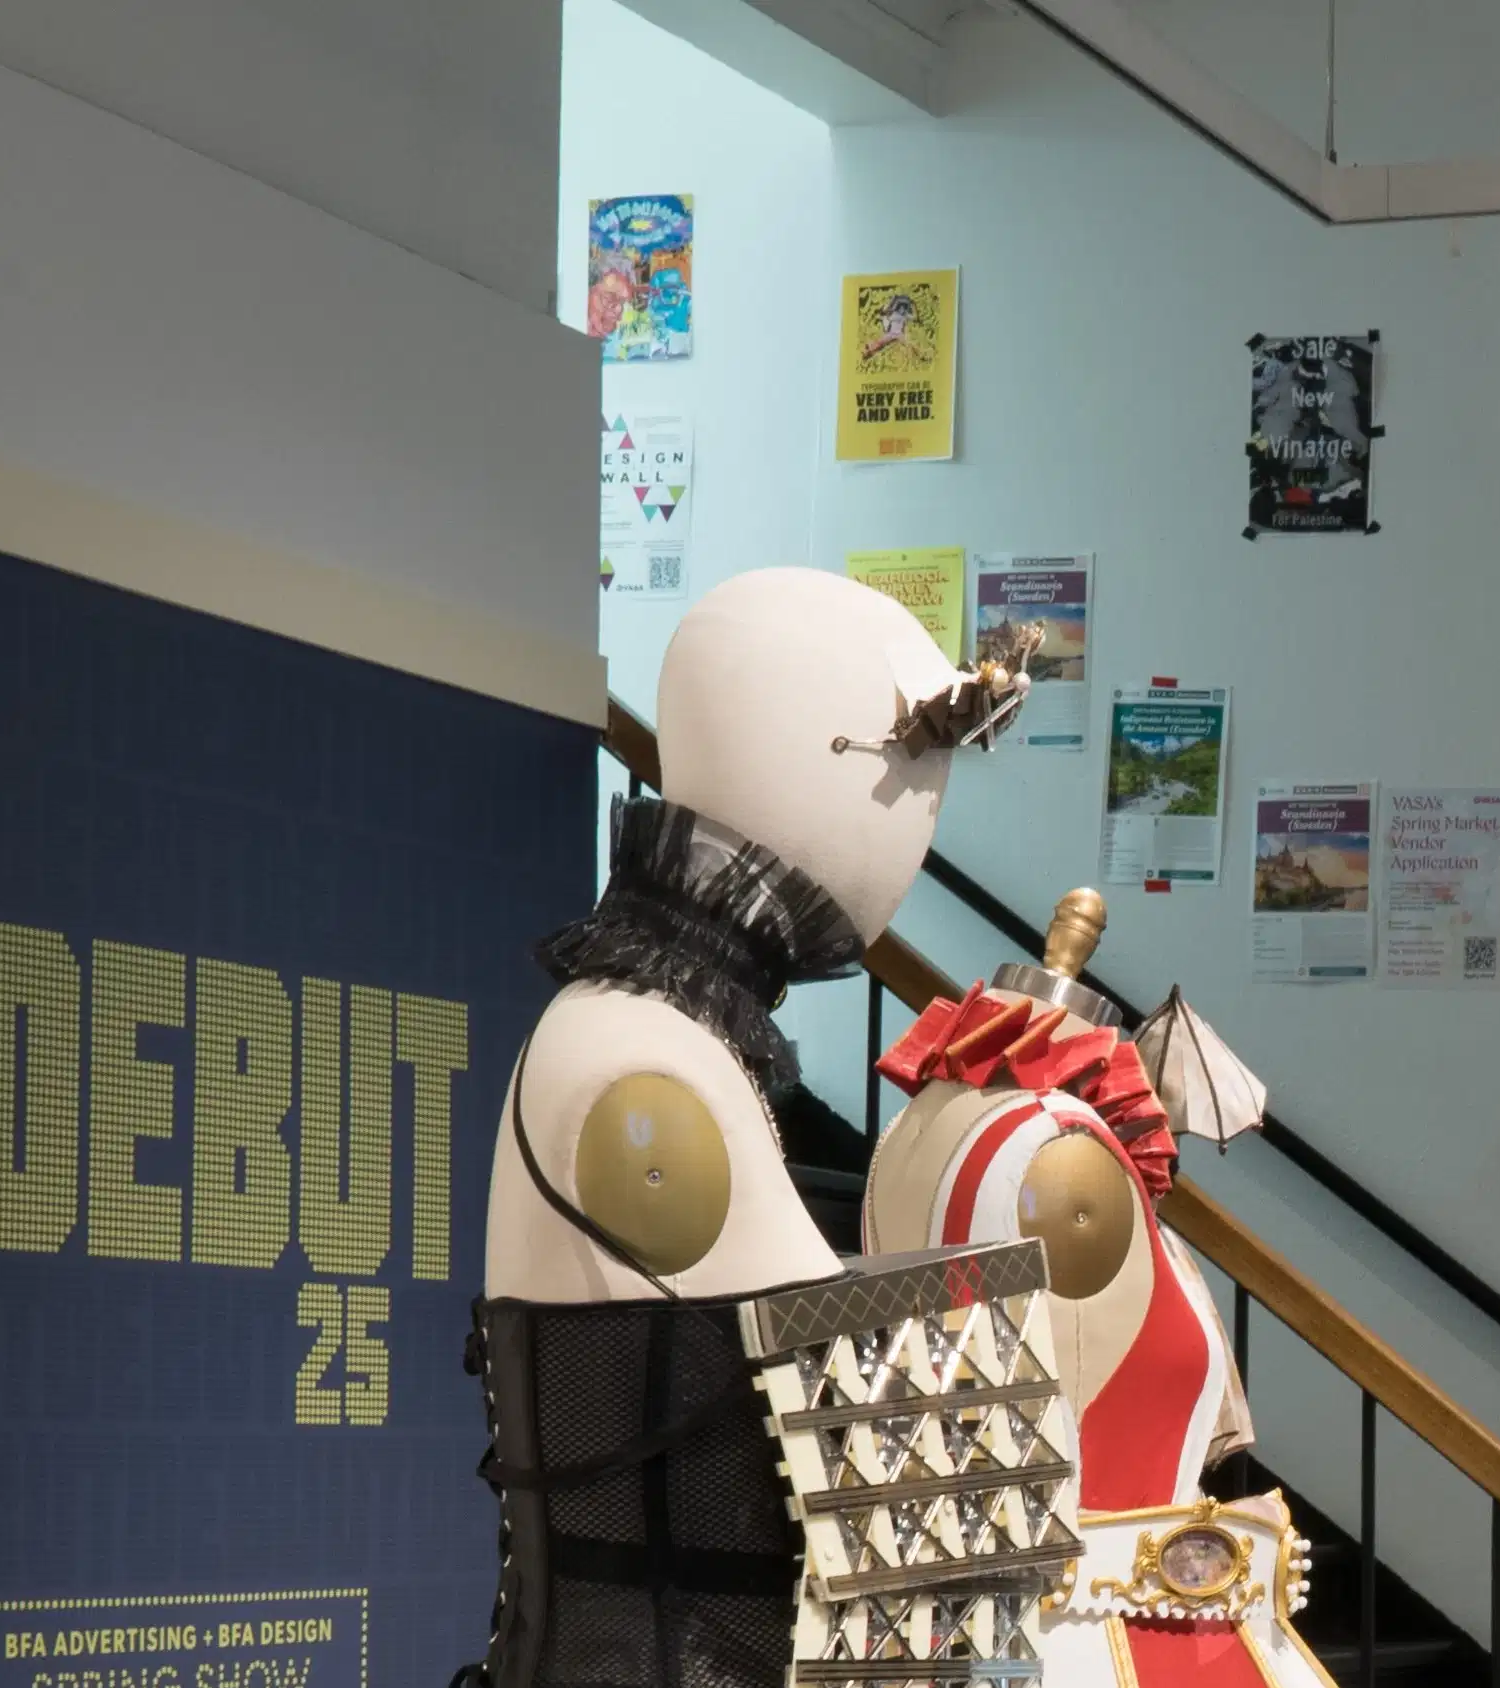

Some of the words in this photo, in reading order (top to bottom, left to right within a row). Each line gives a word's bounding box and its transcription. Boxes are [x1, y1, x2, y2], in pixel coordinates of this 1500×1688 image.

[1291, 336, 1337, 359] Sale
[856, 392, 895, 407] VERY
[898, 390, 933, 405] FREE
[1291, 387, 1335, 407] New
[857, 407, 890, 422] AND
[894, 405, 935, 421] WILD.
[603, 452, 684, 465] ESIGN
[1269, 434, 1353, 467] Vinatge
[600, 471, 665, 483] WALL
[1000, 580, 1063, 591] Scandinavia
[1008, 591, 1055, 604] (Sweden)
[1280, 808, 1346, 819] Scandinavia
[1288, 820, 1338, 831] (Sweden)
[1390, 815, 1441, 833] Spring
[1445, 816, 1500, 831] Market
[1390, 835, 1447, 850] Vendor
[1390, 856, 1479, 872] Application
[295, 1282, 391, 1426] 25
[5, 1632, 47, 1659] BFA
[53, 1625, 197, 1657] ADVERTISING
[203, 1630, 213, 1645] +
[218, 1622, 255, 1648] BFA
[260, 1617, 332, 1646] DESIGN
